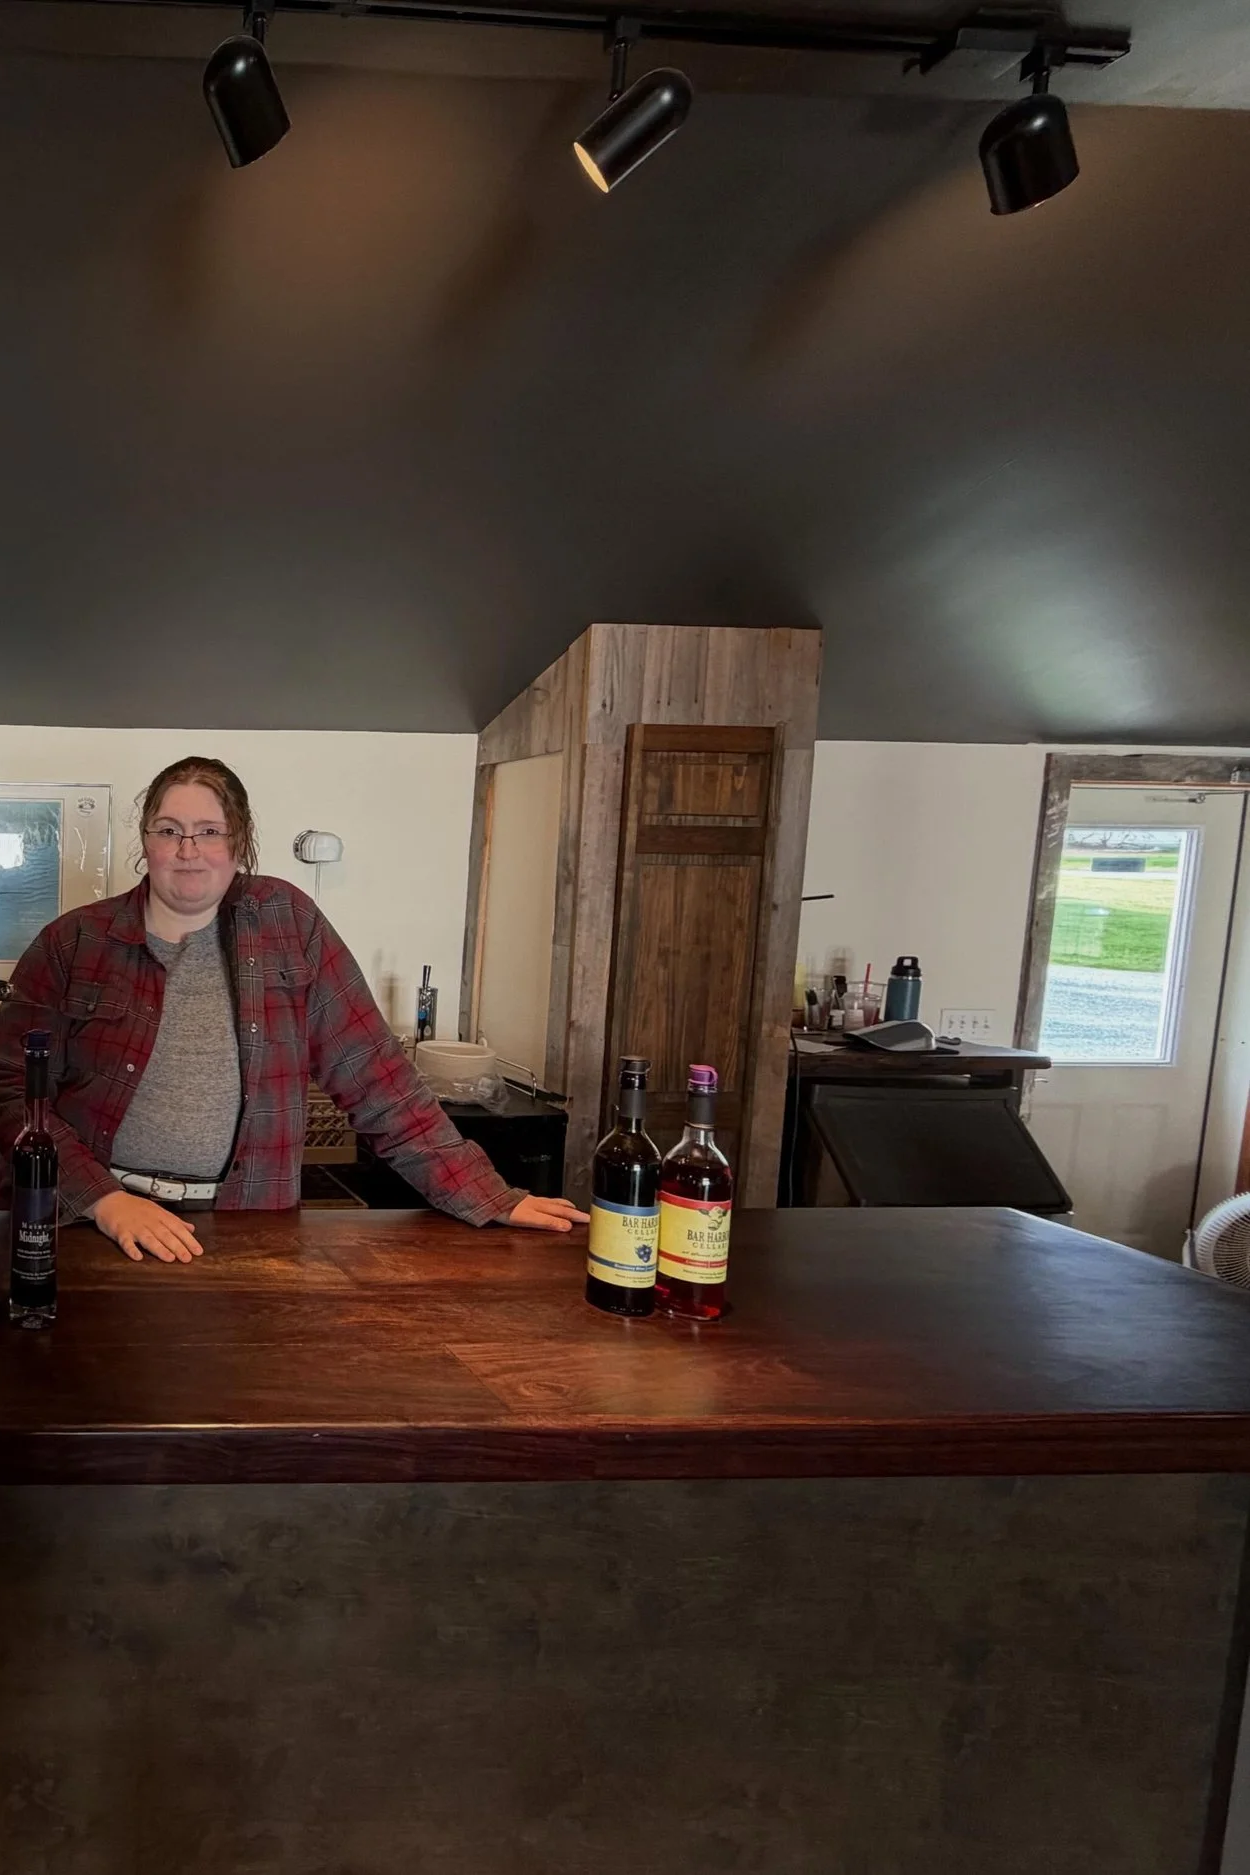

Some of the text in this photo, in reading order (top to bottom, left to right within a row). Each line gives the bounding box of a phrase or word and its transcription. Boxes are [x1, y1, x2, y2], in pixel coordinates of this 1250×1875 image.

[622, 1216, 639, 1228] BAR
[19, 1229, 50, 1247] Midnight
[687, 1229, 705, 1242] BAR
